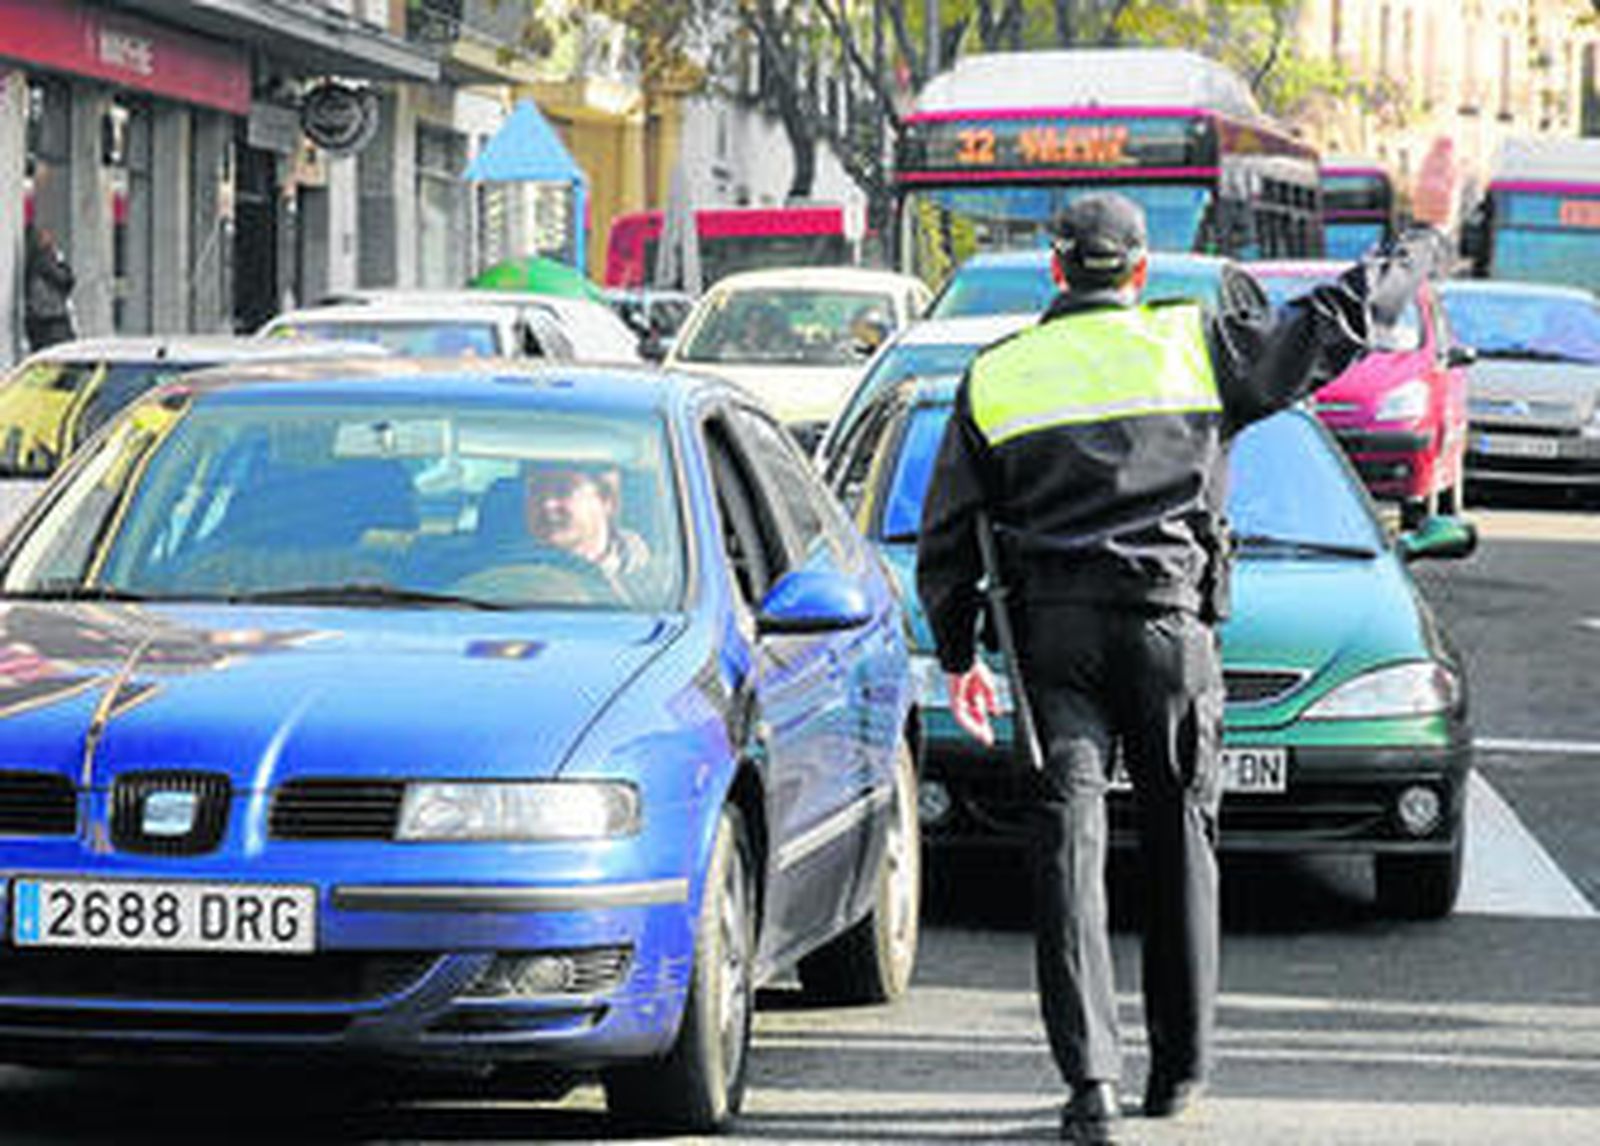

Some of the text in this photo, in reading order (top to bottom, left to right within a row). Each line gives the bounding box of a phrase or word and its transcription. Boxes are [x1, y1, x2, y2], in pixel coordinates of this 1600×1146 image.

[955, 127, 995, 163] 32
[48, 888, 299, 942] 2688 DRG
